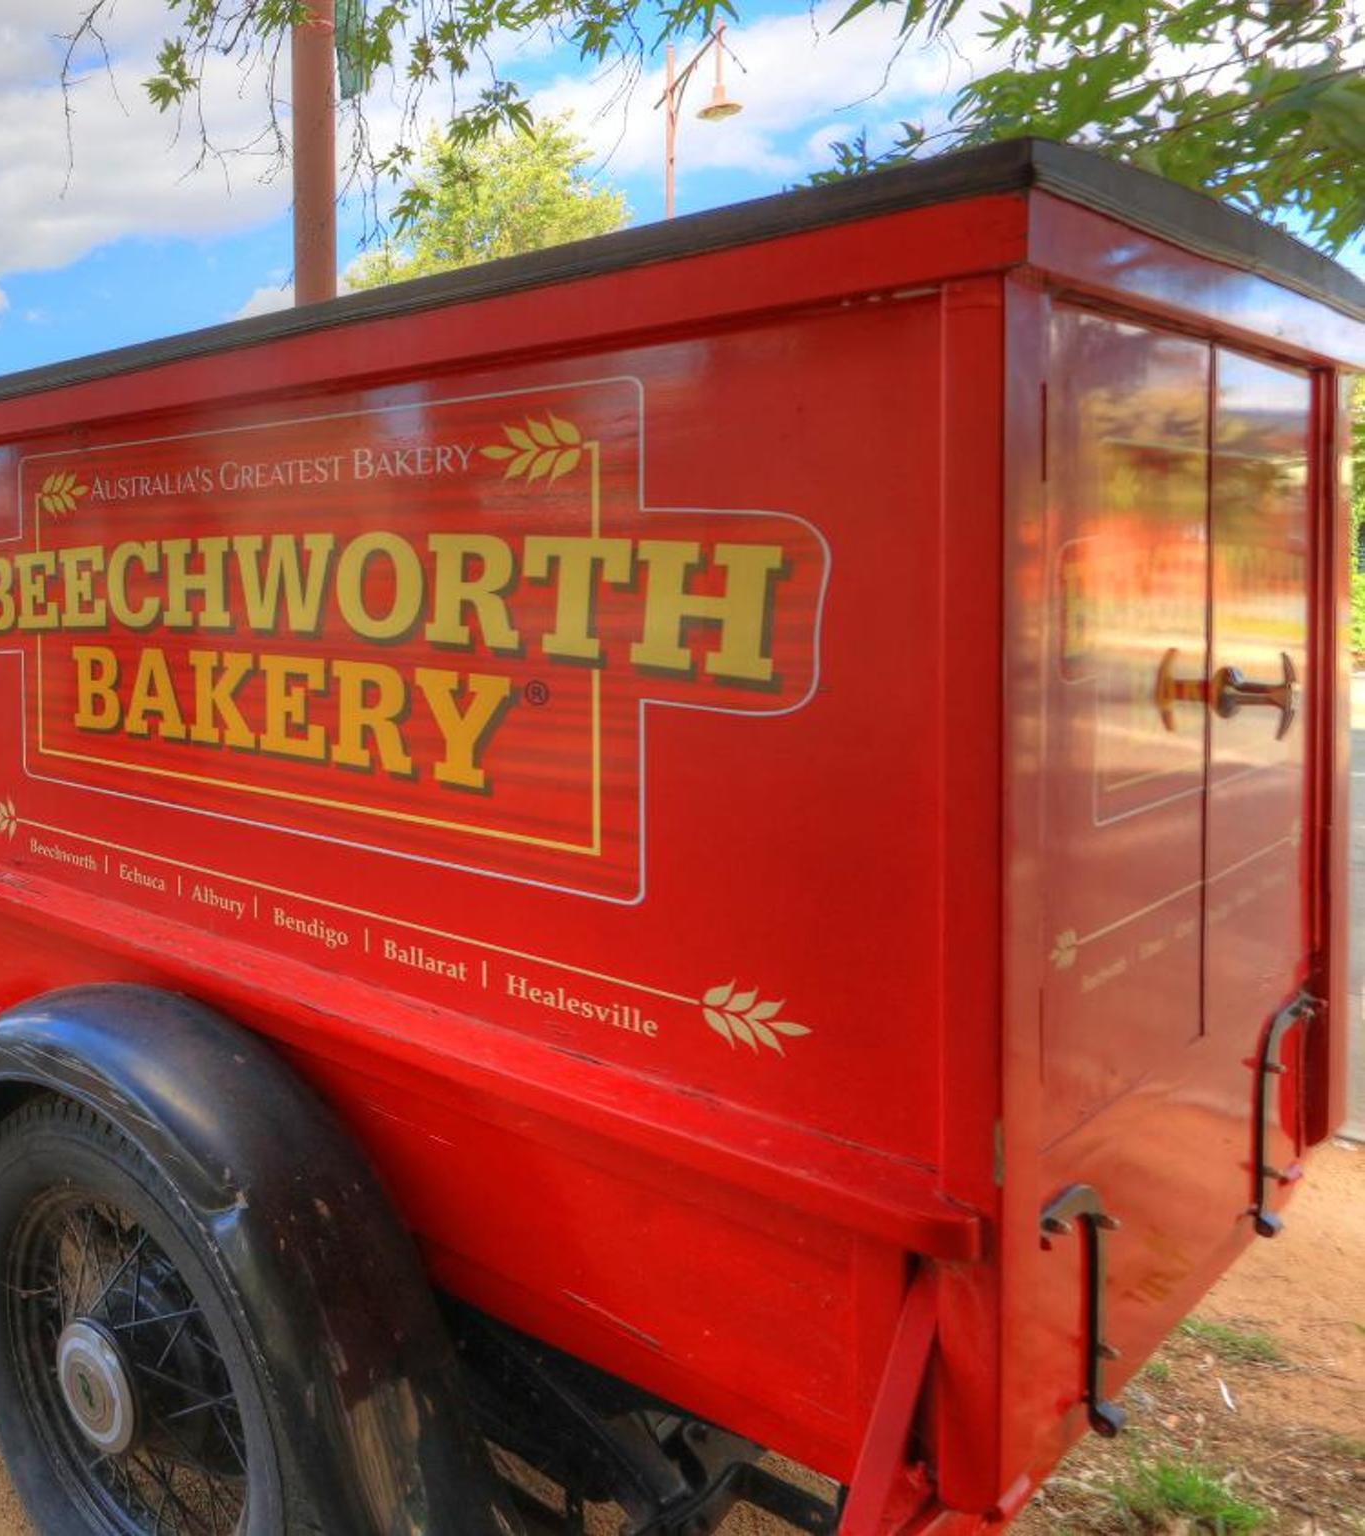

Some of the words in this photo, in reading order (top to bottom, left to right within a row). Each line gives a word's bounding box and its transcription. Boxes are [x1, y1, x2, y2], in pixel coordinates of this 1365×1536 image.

[90, 467, 214, 502] AUSTRALIA'S
[219, 455, 340, 491] GREATEST
[352, 444, 476, 480] BAKERY
[30, 837, 98, 873] Beechworth
[119, 863, 166, 892] Echuca
[191, 884, 247, 920] Albury
[273, 907, 350, 950] Bendigo
[383, 939, 468, 982] Ballarat
[505, 972, 659, 1038] Healesville
